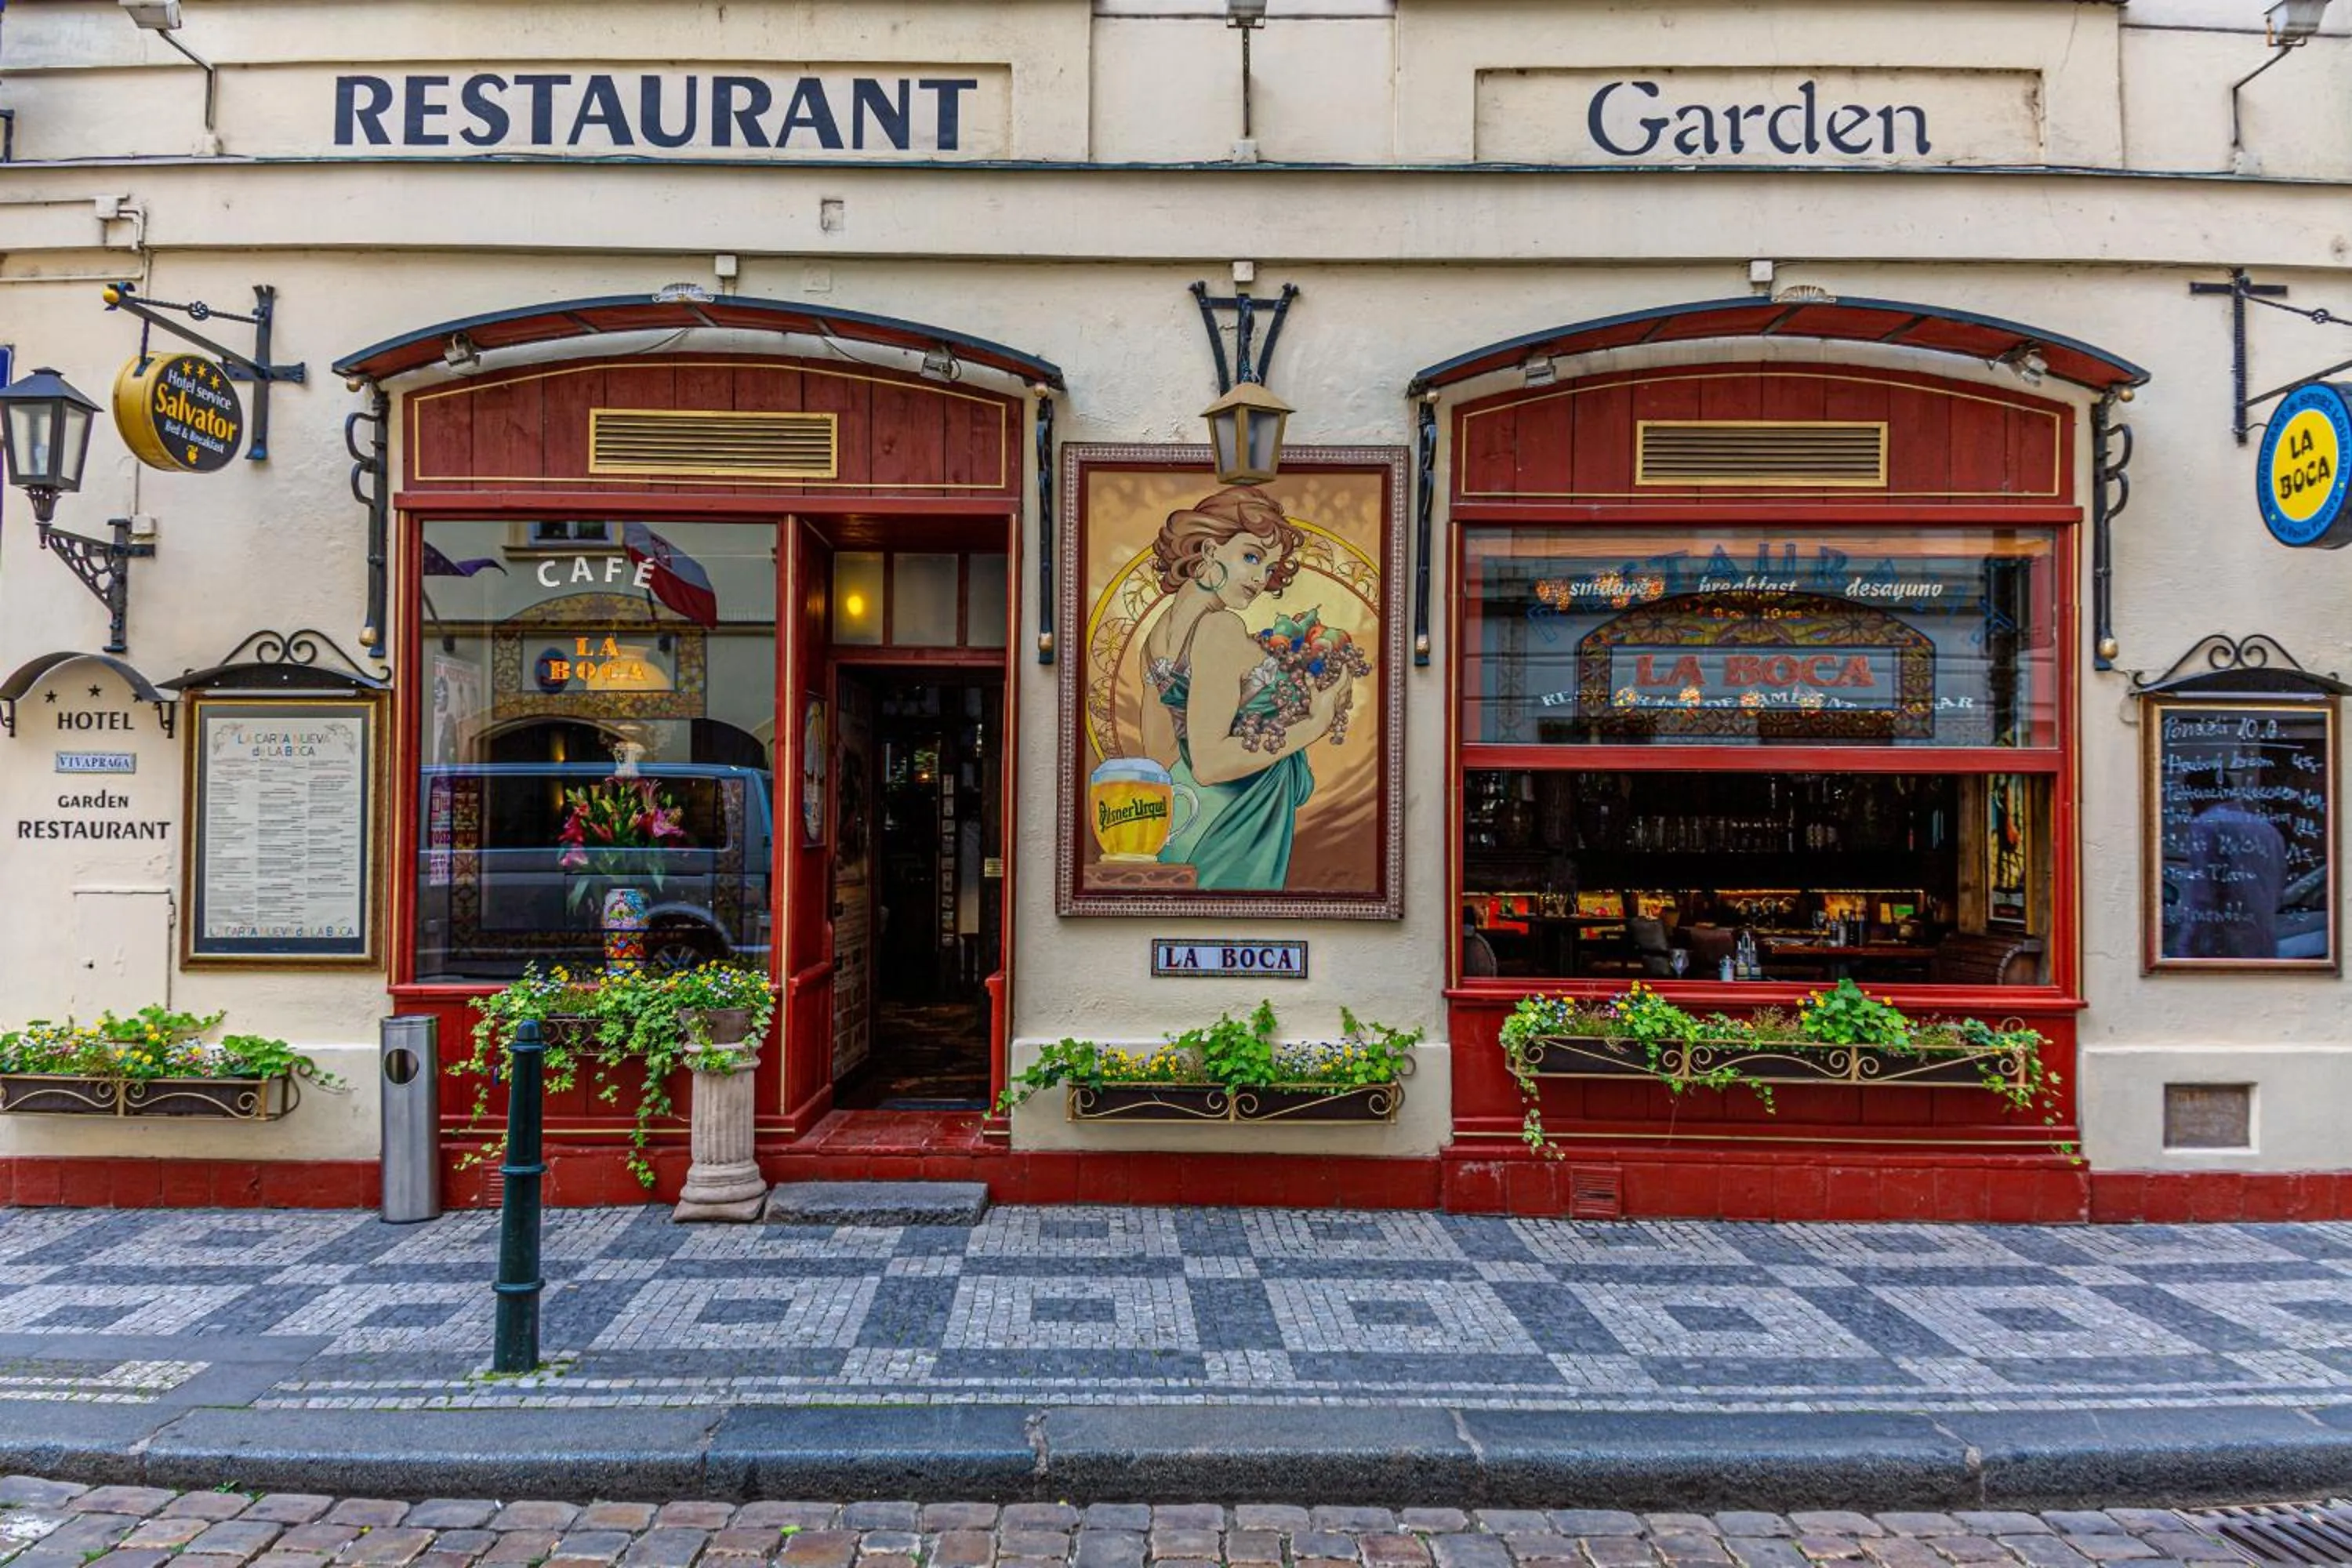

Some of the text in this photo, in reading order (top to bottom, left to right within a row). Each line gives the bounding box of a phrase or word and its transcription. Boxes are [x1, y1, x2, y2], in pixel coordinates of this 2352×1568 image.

[334, 74, 978, 151] RESTAURANT
[1588, 79, 1932, 158] Garden
[167, 368, 231, 410] Hotel service
[155, 382, 238, 444] Salvator
[2289, 428, 2314, 459] LA
[2279, 455, 2331, 499] BOCA
[537, 556, 655, 589] CAFÉ
[1844, 577, 1944, 604] desayuno
[575, 637, 622, 657] LA
[549, 659, 647, 682] BOCA
[1633, 655, 1875, 688] LA BOCA
[57, 711, 135, 730] HOTEL
[255, 733, 290, 744] CARTA
[267, 746, 282, 757] LA
[285, 746, 316, 757] BOCA
[60, 757, 131, 768] VIVAPRAGA
[18, 821, 171, 840] RESTAURANT
[1099, 800, 1134, 833] Pilsner
[1165, 946, 1293, 969] LA BOCA
